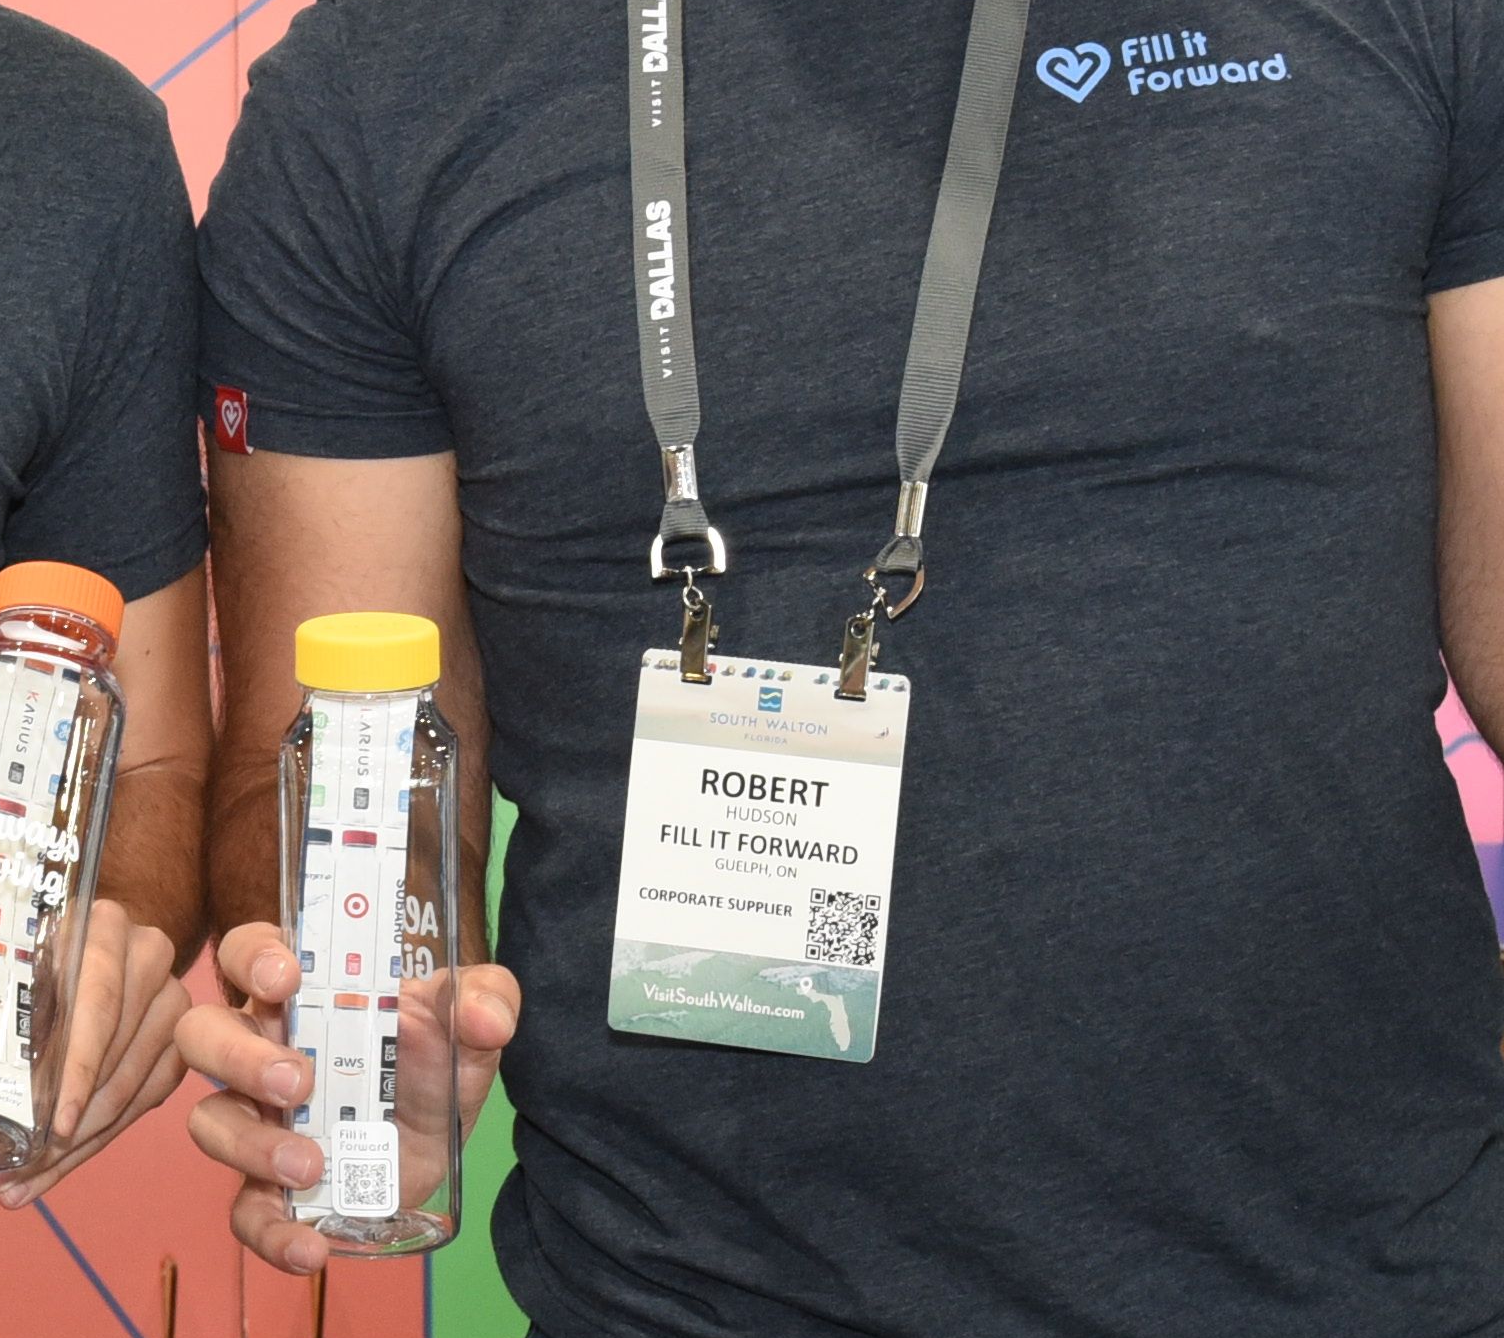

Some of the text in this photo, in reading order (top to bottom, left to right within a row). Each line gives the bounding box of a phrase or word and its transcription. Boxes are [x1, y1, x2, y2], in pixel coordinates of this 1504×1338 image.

[1121, 29, 1209, 66] Fill it
[1129, 52, 1285, 95] Forward
[650, 79, 662, 128] VISIT
[648, 199, 674, 378] VISIT DALLAS
[15, 691, 40, 755] KARIUS
[709, 711, 829, 736] SOUTH WALTON
[743, 733, 788, 745] FLORIDA
[700, 768, 831, 808] ROBERT
[725, 805, 798, 827] HUDSON
[660, 823, 859, 866] FILL IT FORWARD
[714, 857, 798, 879] GUELPH, ON
[638, 886, 793, 918] CORPORATE SUPPLIER
[642, 981, 806, 1021] VisitSouthWalton.com
[333, 1056, 365, 1070] aws
